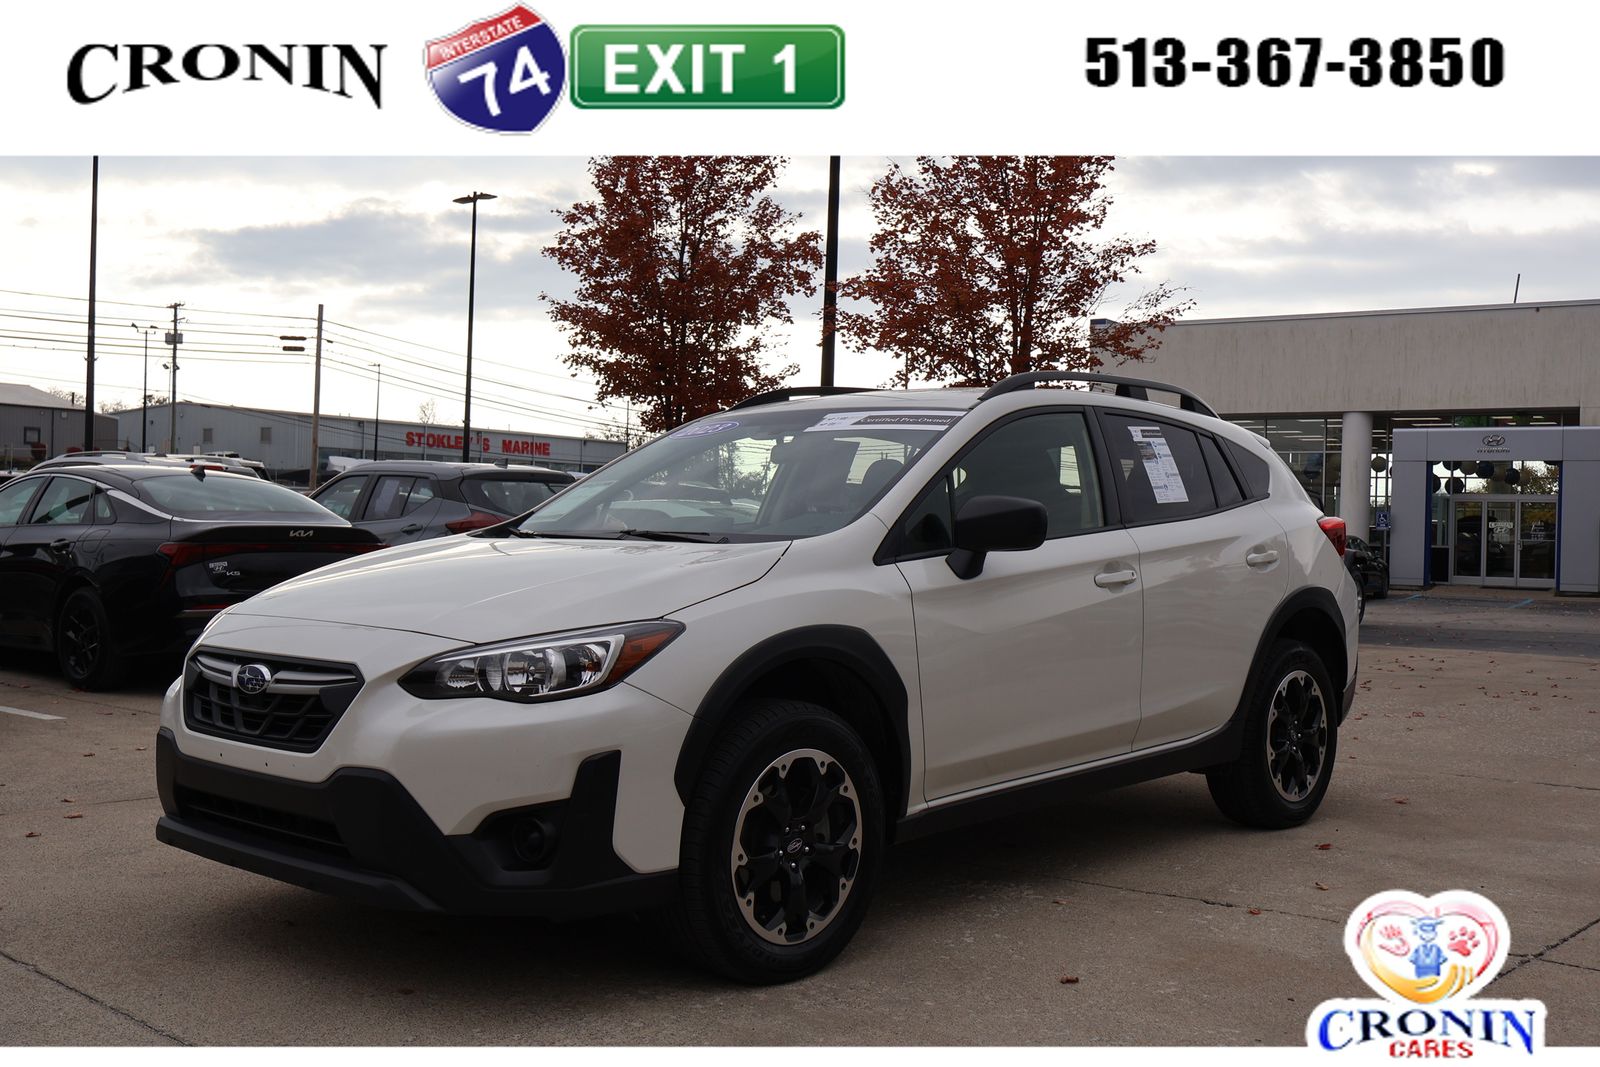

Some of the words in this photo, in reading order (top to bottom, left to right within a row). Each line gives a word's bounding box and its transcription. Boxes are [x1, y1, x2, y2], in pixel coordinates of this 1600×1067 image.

[406, 431, 490, 452] STOKLE'S
[502, 439, 550, 456] MARINE
[289, 529, 313, 537] KIA
